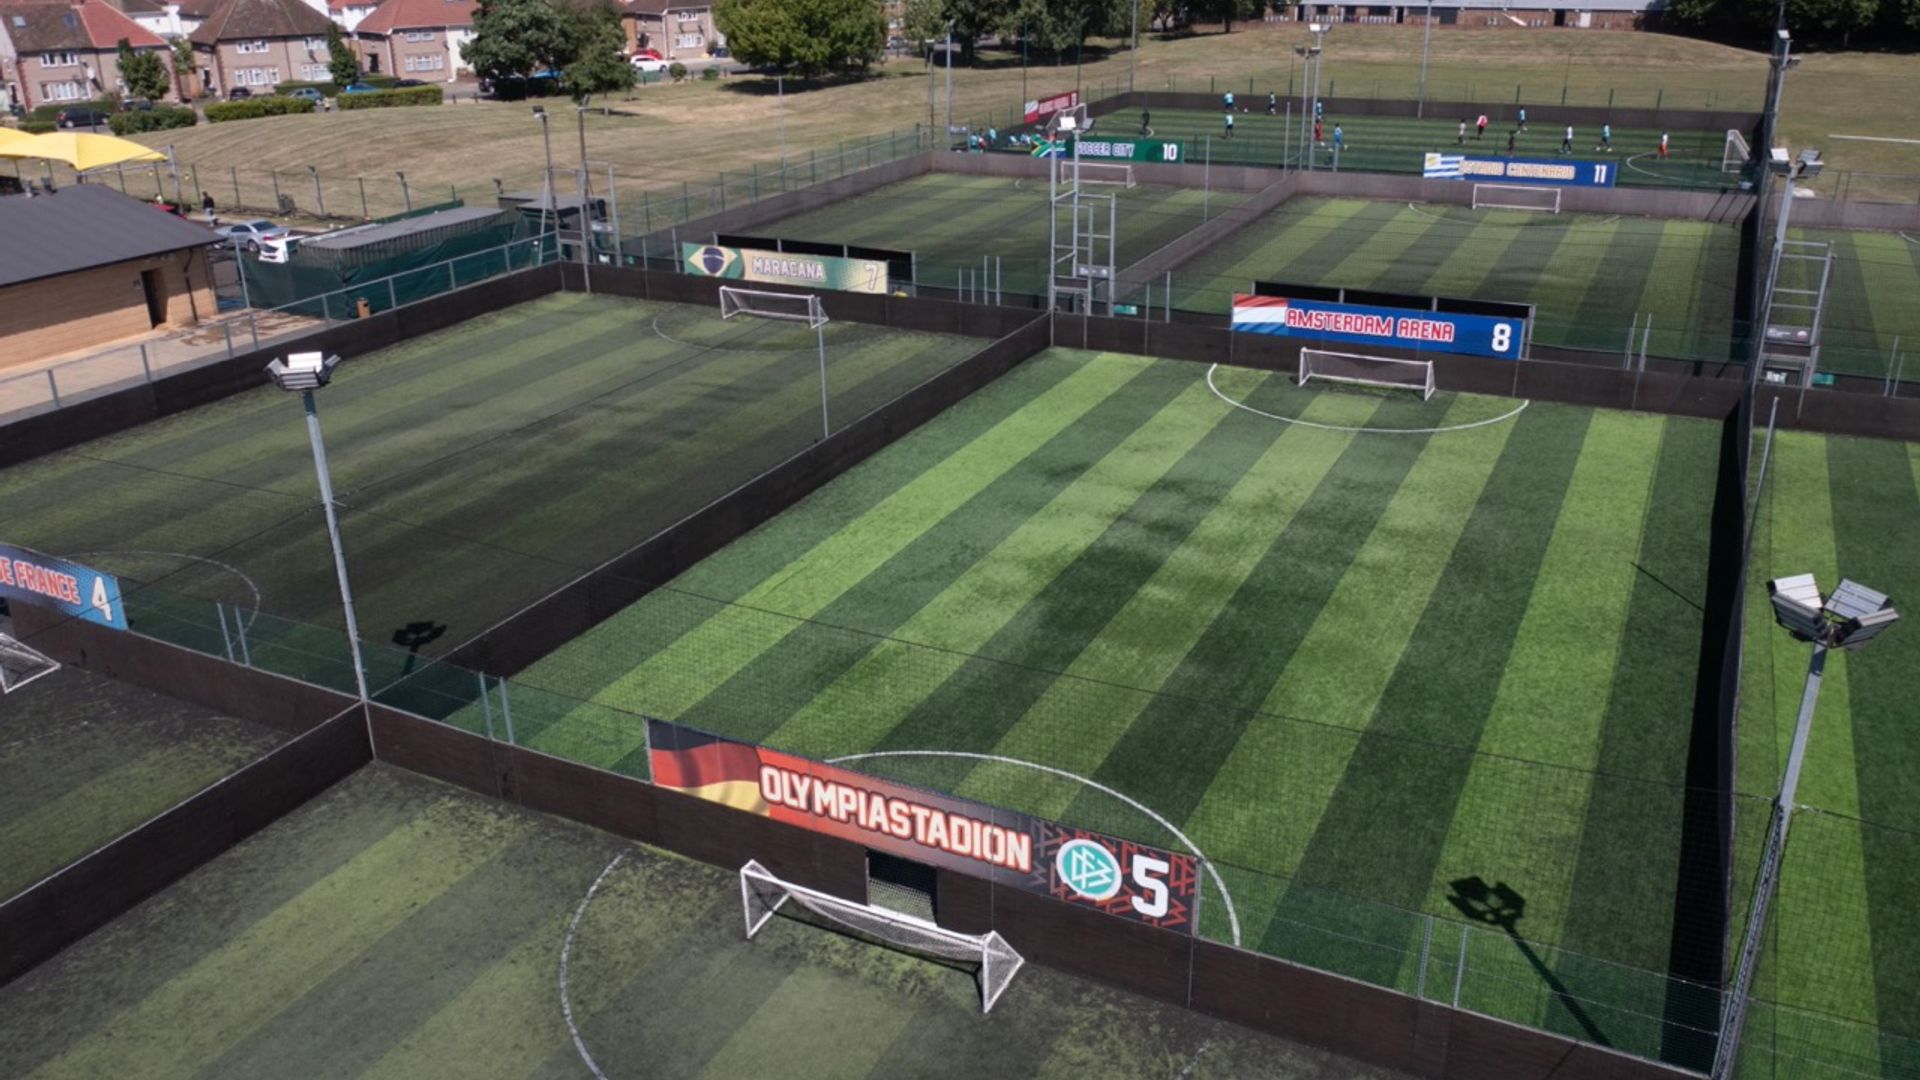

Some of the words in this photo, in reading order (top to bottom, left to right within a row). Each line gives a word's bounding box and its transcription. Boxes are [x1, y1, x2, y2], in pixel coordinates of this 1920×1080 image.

[1113, 143, 1135, 157] CITY
[1163, 143, 1177, 160] 10
[1594, 164, 1607, 183] 11
[752, 257, 826, 281] MARACANA
[865, 264, 879, 290] 7
[1285, 309, 1393, 336] AMSTERDAM
[1397, 320, 1455, 343] ARENA
[1491, 323, 1511, 352] 8
[14, 560, 81, 605] FRANCE
[92, 576, 112, 621] 4
[759, 765, 1032, 873] OLYMPIASTADION
[1131, 854, 1169, 918] 5
